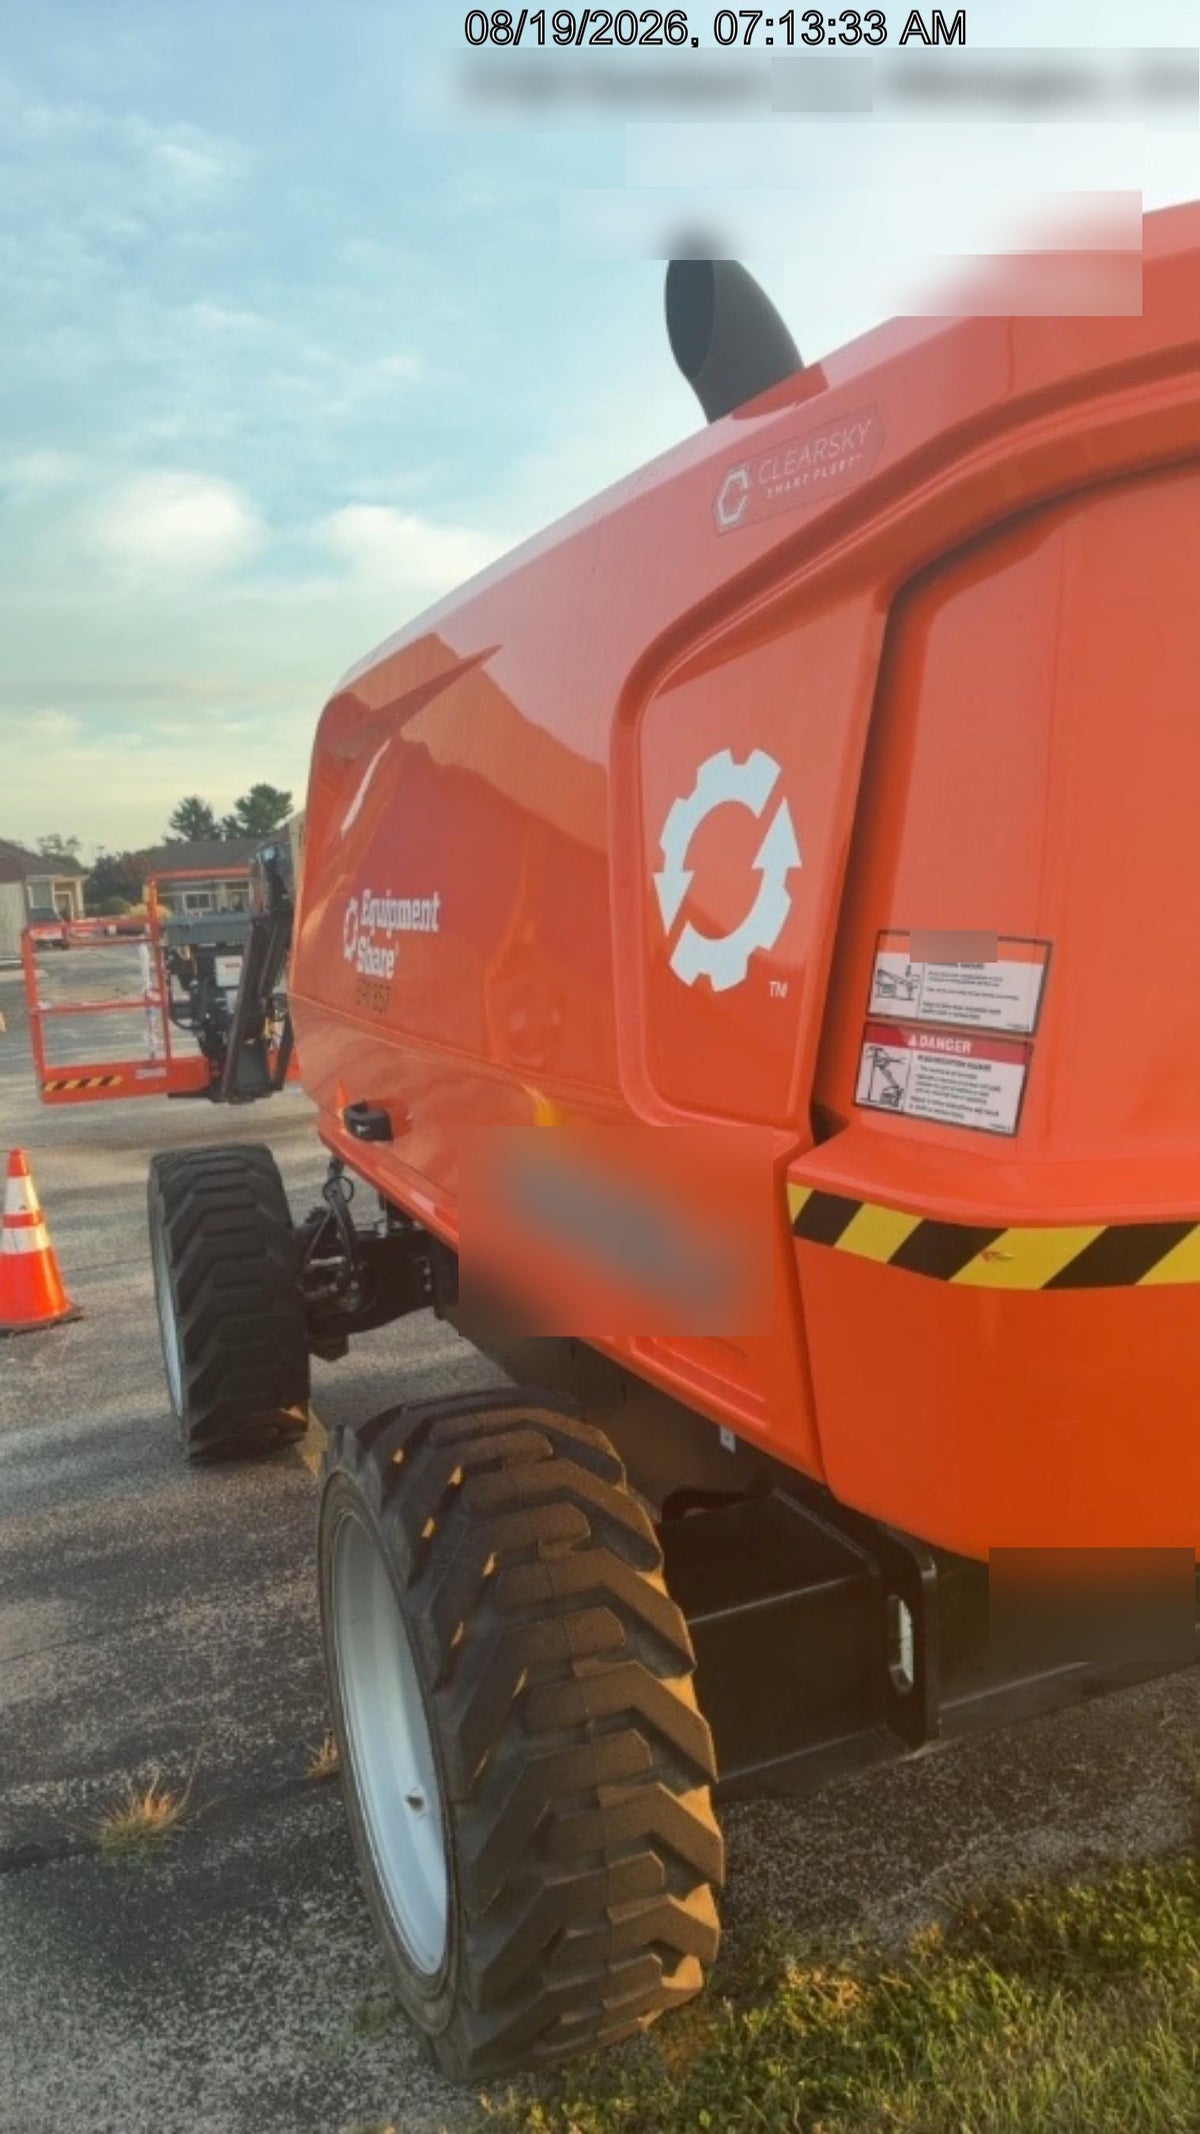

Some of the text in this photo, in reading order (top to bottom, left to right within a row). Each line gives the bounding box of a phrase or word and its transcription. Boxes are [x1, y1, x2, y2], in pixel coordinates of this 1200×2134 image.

[758, 419, 872, 485] CLEARSKY
[360, 888, 440, 940] Equipment
[357, 935, 395, 980] Share
[919, 1034, 971, 1053] DANGER
